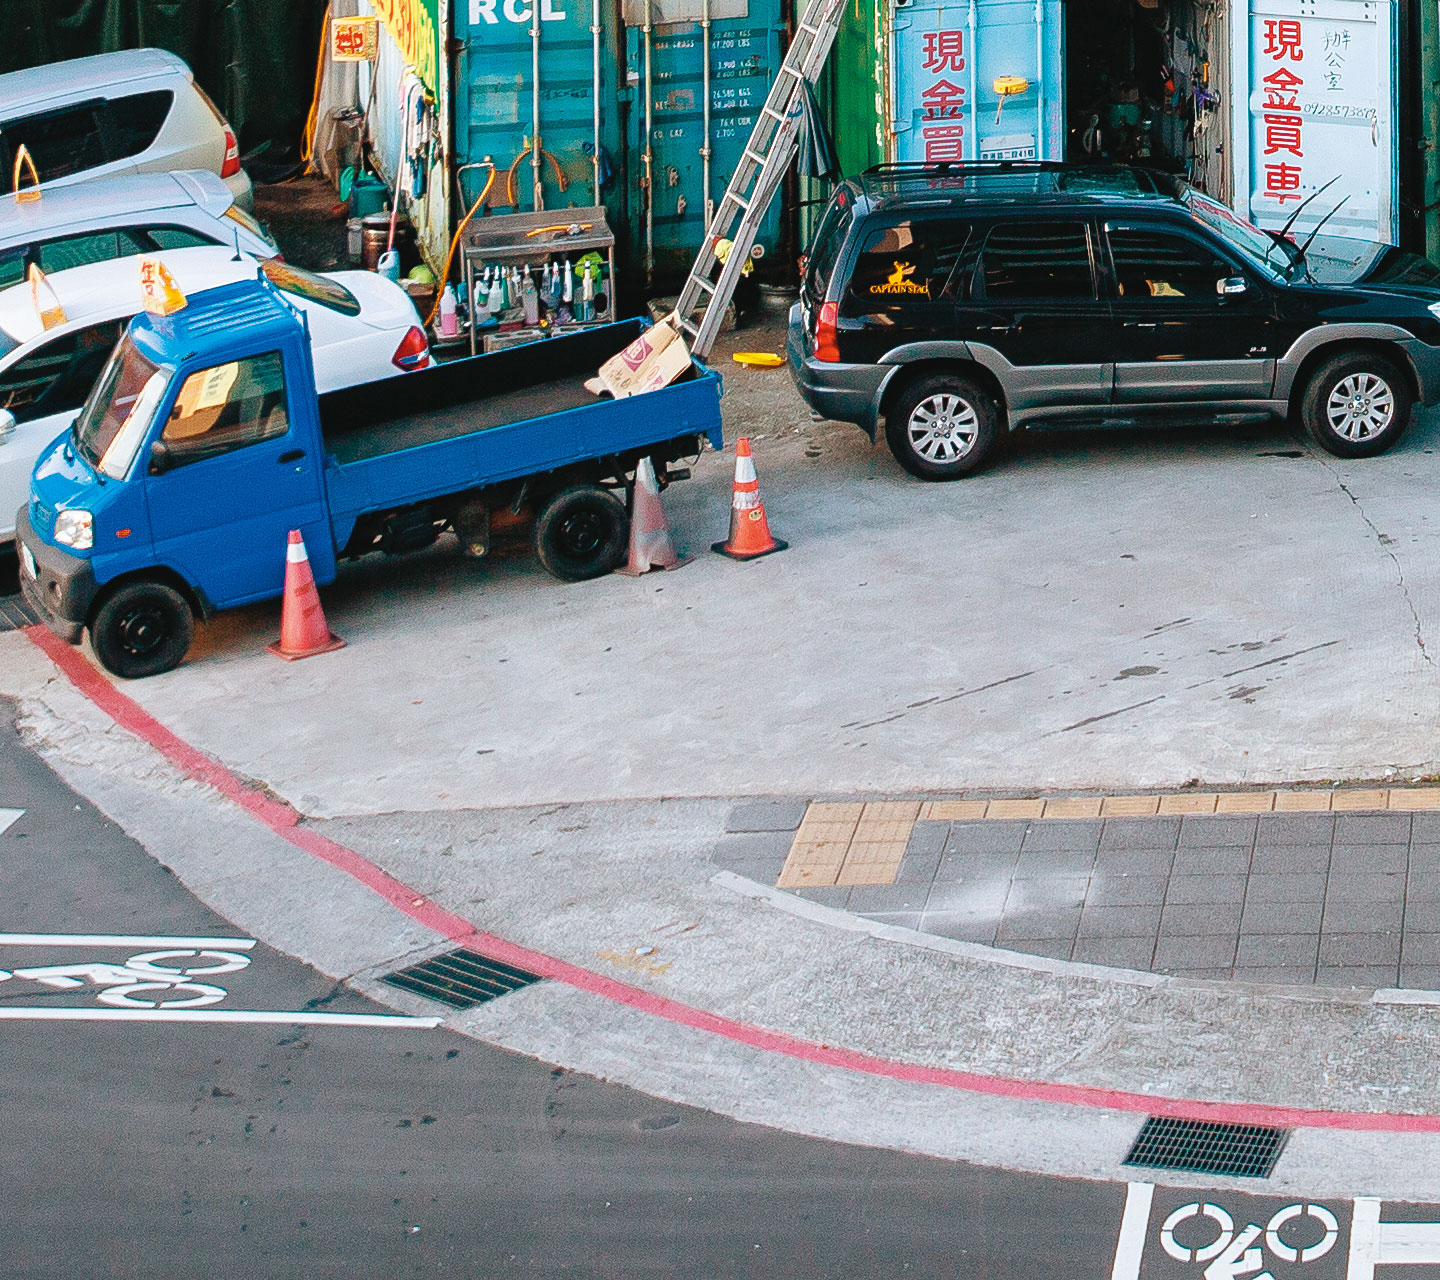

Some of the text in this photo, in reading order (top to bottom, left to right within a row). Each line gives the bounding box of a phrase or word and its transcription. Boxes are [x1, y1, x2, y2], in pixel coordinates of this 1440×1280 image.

[921, 29, 967, 188] 現金買
[1262, 19, 1304, 205] 現金買車
[1321, 28, 1353, 91] 辦公室
[869, 284, 907, 294] CAPTAIN
